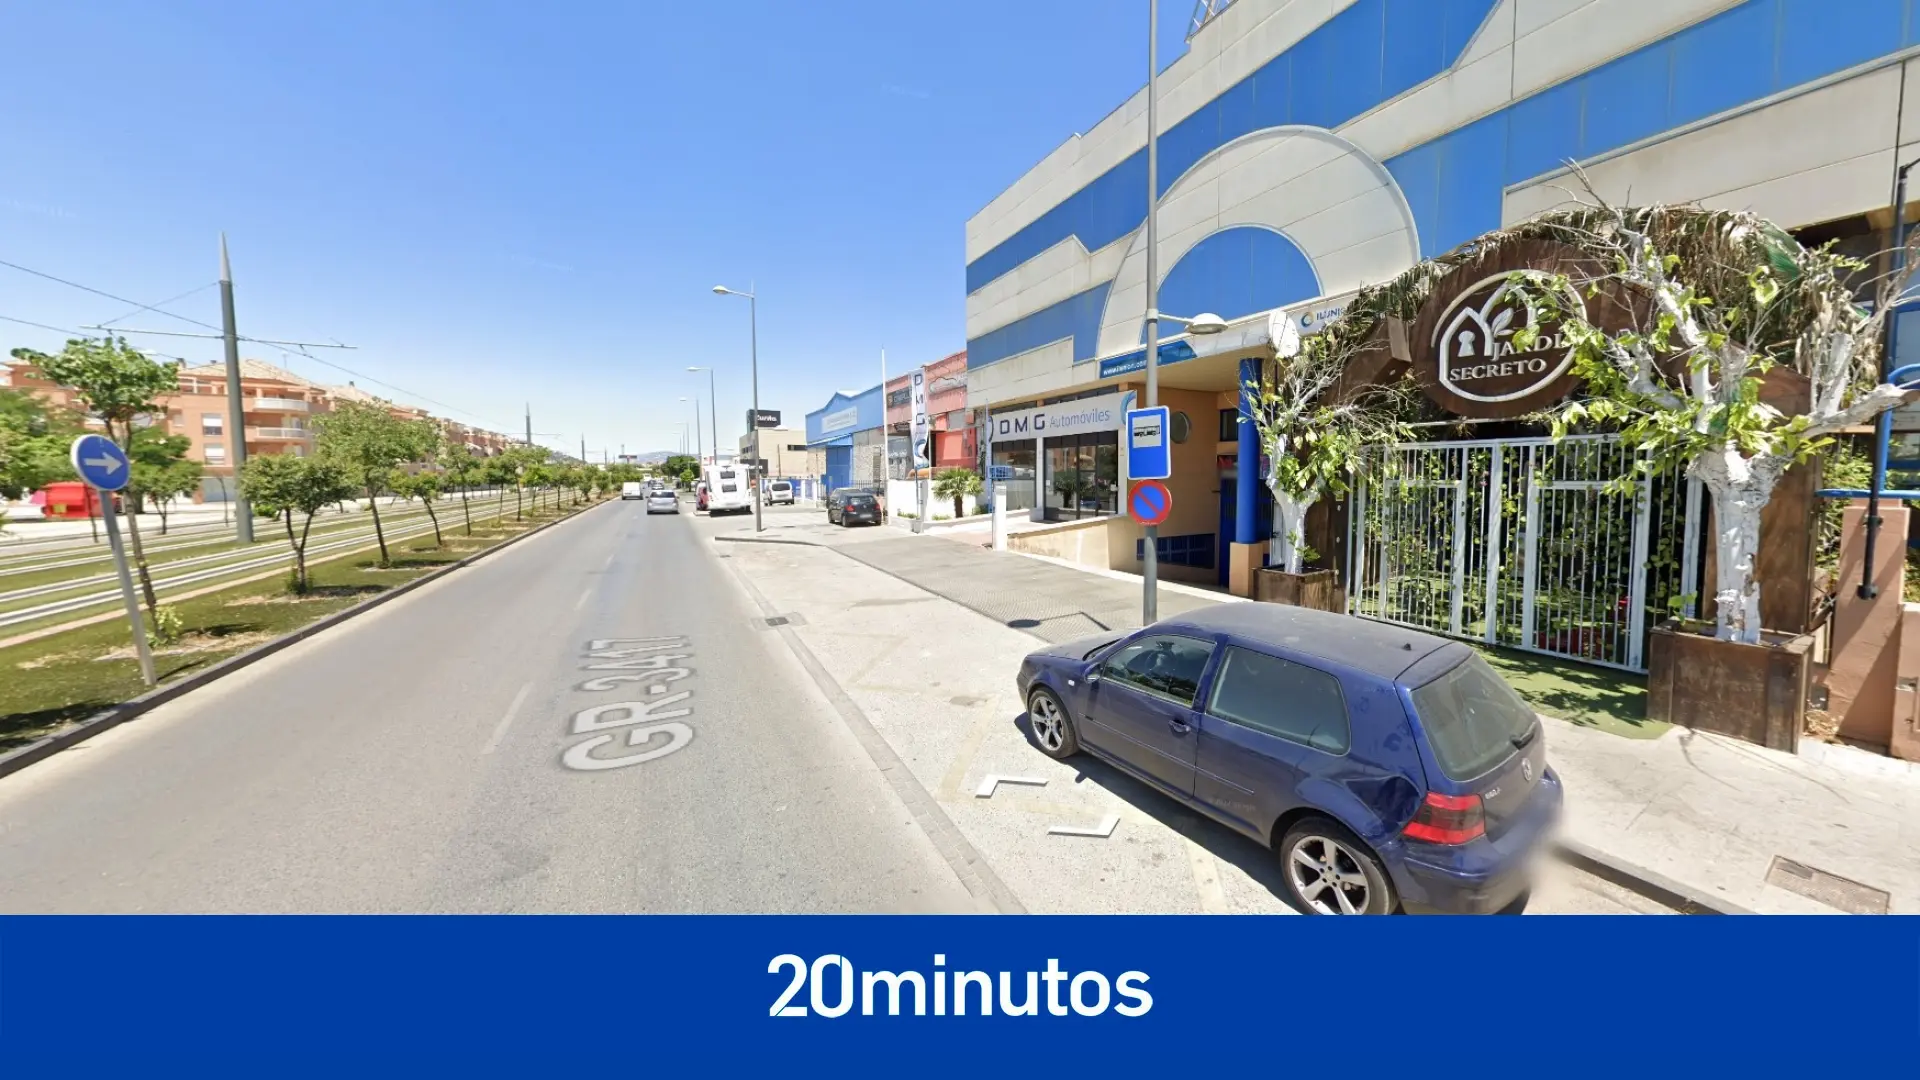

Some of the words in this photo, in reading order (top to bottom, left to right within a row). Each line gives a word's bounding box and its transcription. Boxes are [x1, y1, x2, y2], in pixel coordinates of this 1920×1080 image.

[1450, 358, 1547, 381] SECRETO
[999, 413, 1046, 435] DMG
[1049, 408, 1111, 429] Automóviles
